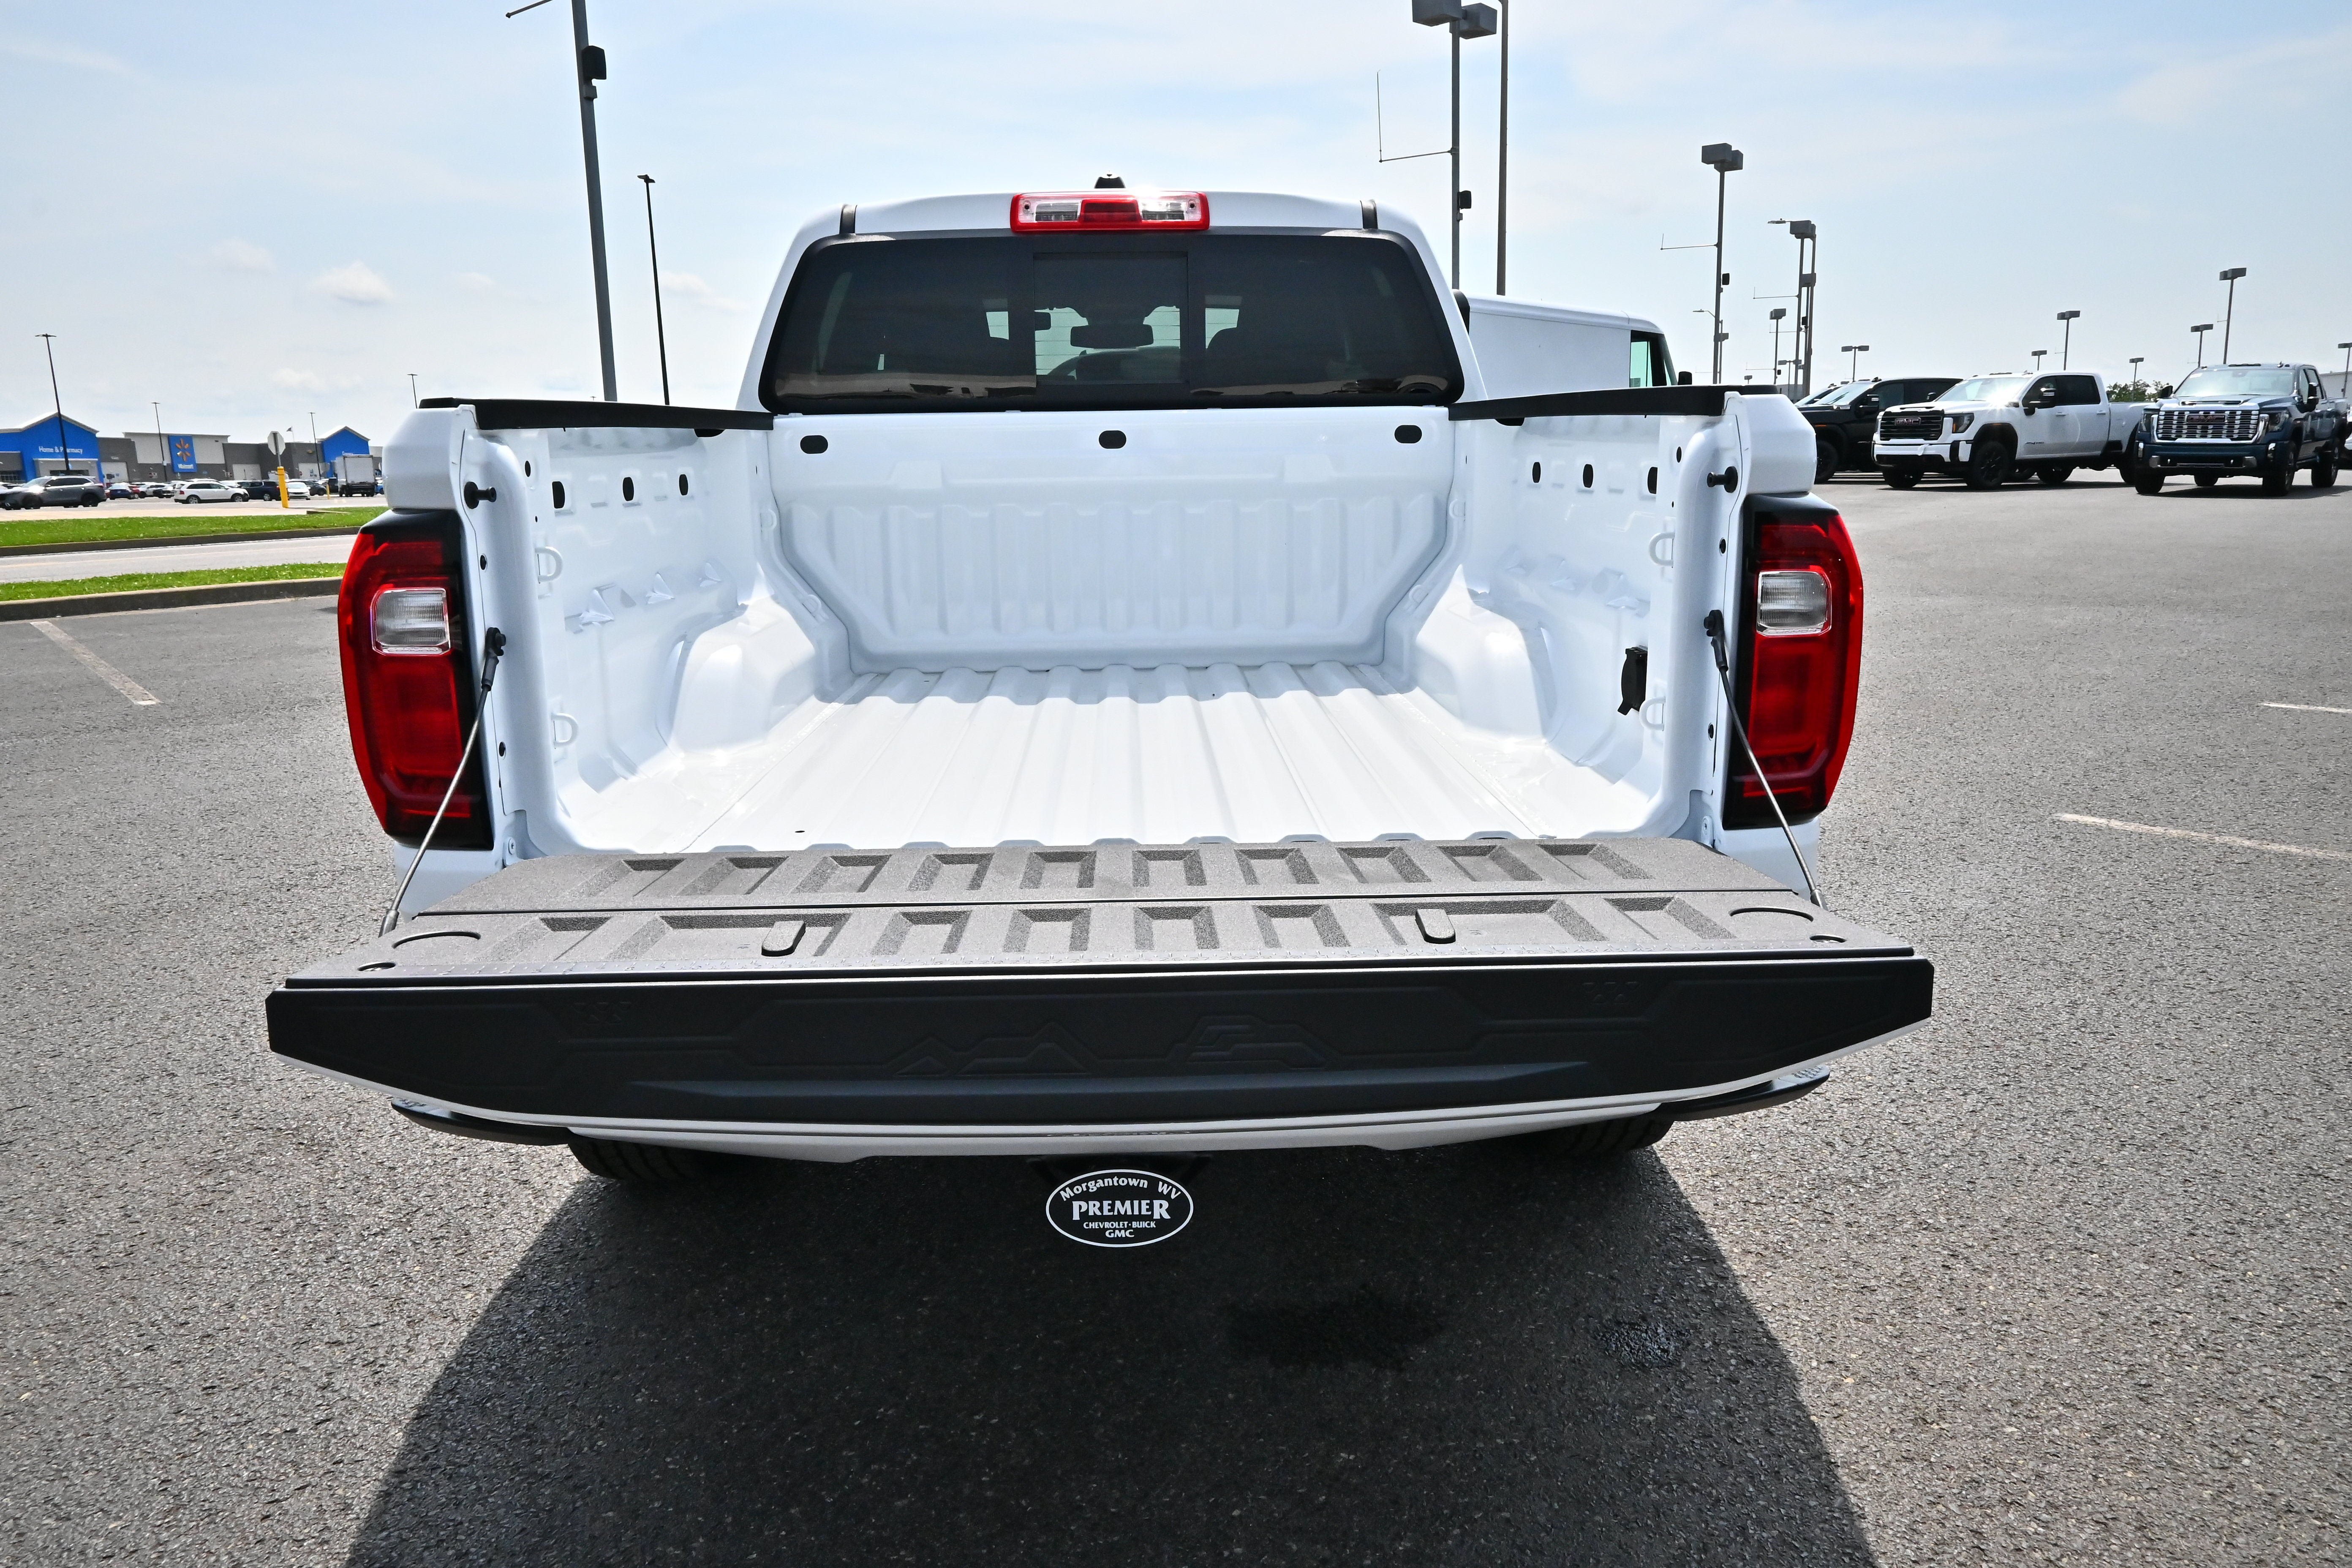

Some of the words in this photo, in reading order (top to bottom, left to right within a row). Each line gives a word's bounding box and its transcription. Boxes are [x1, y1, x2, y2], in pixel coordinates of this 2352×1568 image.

[60, 446, 83, 455] Parmacy
[1059, 1176, 1148, 1201] Morgantown
[1158, 1181, 1181, 1200] WV
[1072, 1199, 1171, 1220] PREMIER
[1105, 1229, 1135, 1238] GMC
